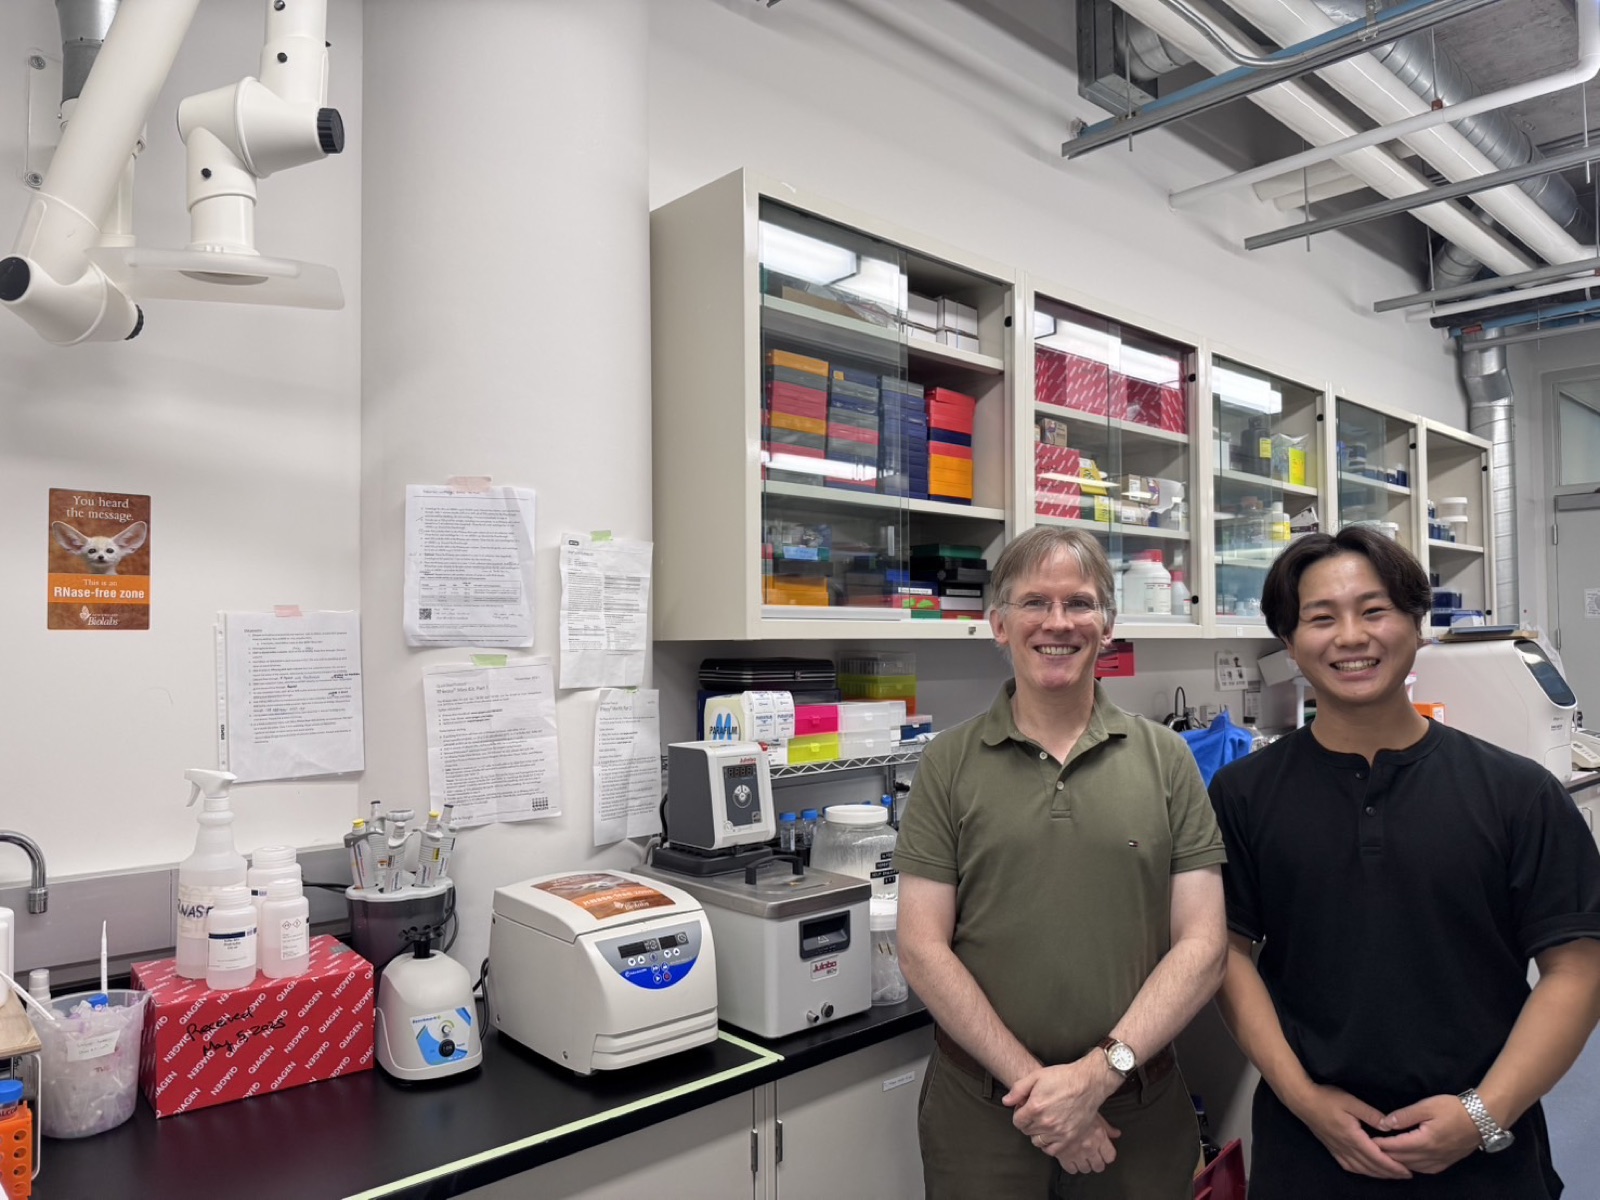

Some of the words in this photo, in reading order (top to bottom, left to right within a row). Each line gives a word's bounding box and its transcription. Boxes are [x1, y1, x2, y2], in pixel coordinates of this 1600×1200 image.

[66, 508, 84, 518] the
[88, 510, 134, 523] message.
[72, 495, 95, 506] You
[98, 496, 129, 509] heard
[53, 586, 117, 599] RNase-free
[119, 590, 145, 599] zone
[709, 726, 738, 735] PARAFILM
[331, 971, 356, 999] QIAGEN
[298, 990, 323, 1018] QIAGEN
[187, 1007, 254, 1041] Received
[318, 1005, 344, 1034] QIAGEN
[283, 1025, 310, 1054] QIAGEN
[339, 1021, 364, 1050] QIAGEN
[187, 1050, 216, 1080] QIAGEN
[248, 1045, 275, 1075] QIAGEN
[304, 1041, 330, 1070] QIAGEN
[210, 1066, 238, 1096] QIAGEN
[270, 1061, 297, 1090] QIAGEN
